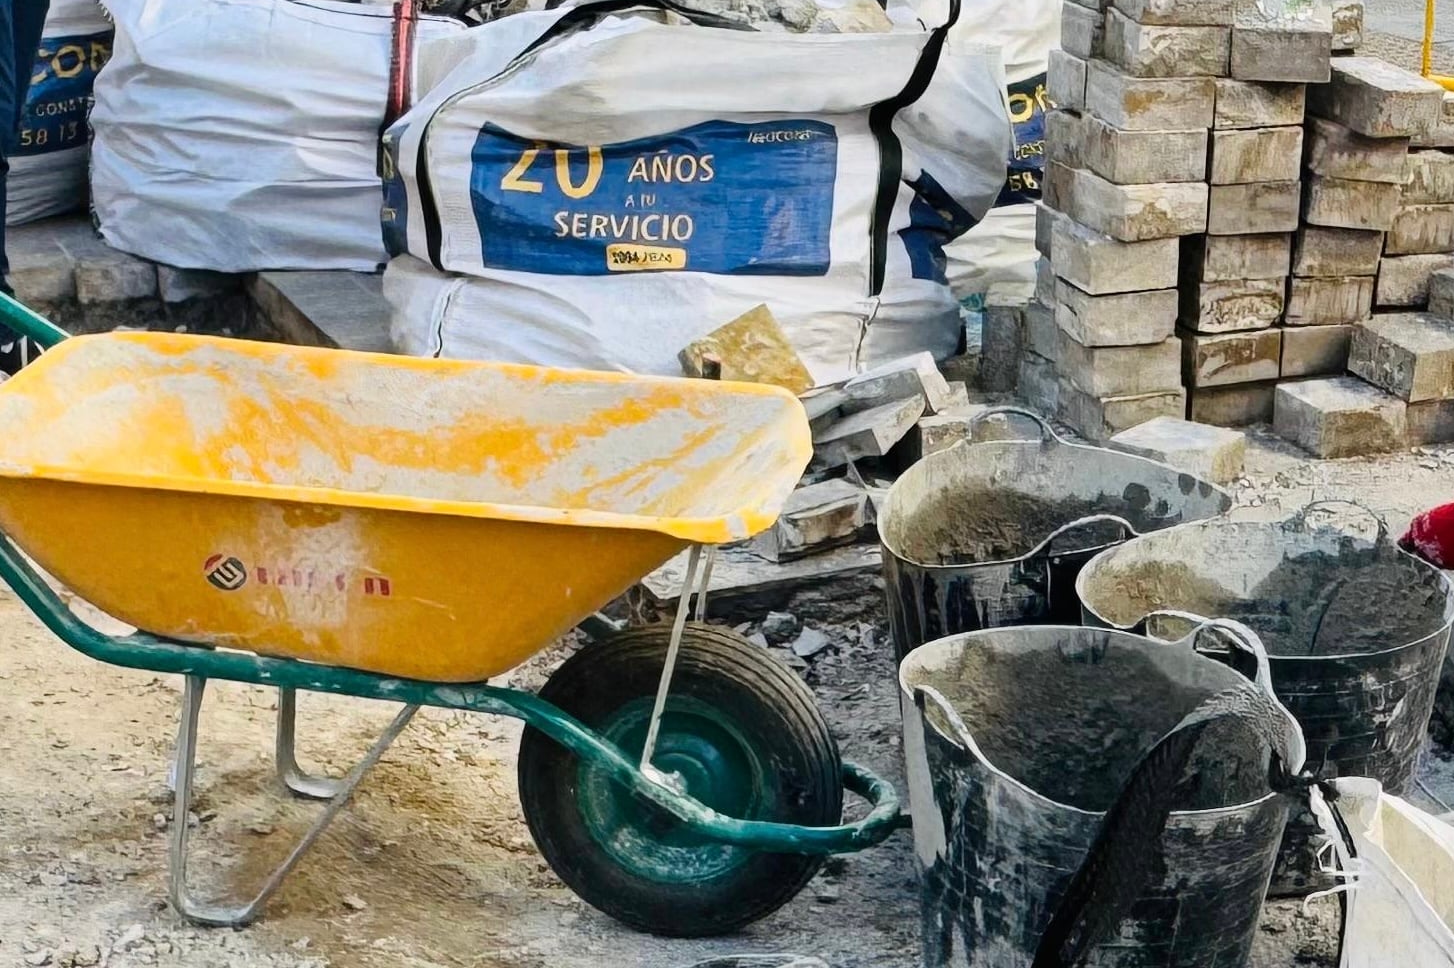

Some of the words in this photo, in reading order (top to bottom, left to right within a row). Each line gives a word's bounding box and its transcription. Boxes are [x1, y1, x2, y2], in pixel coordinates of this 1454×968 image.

[500, 142, 605, 200] 20
[627, 150, 716, 184] AÑOS
[624, 195, 635, 208] A
[553, 210, 694, 242] SERVICIO
